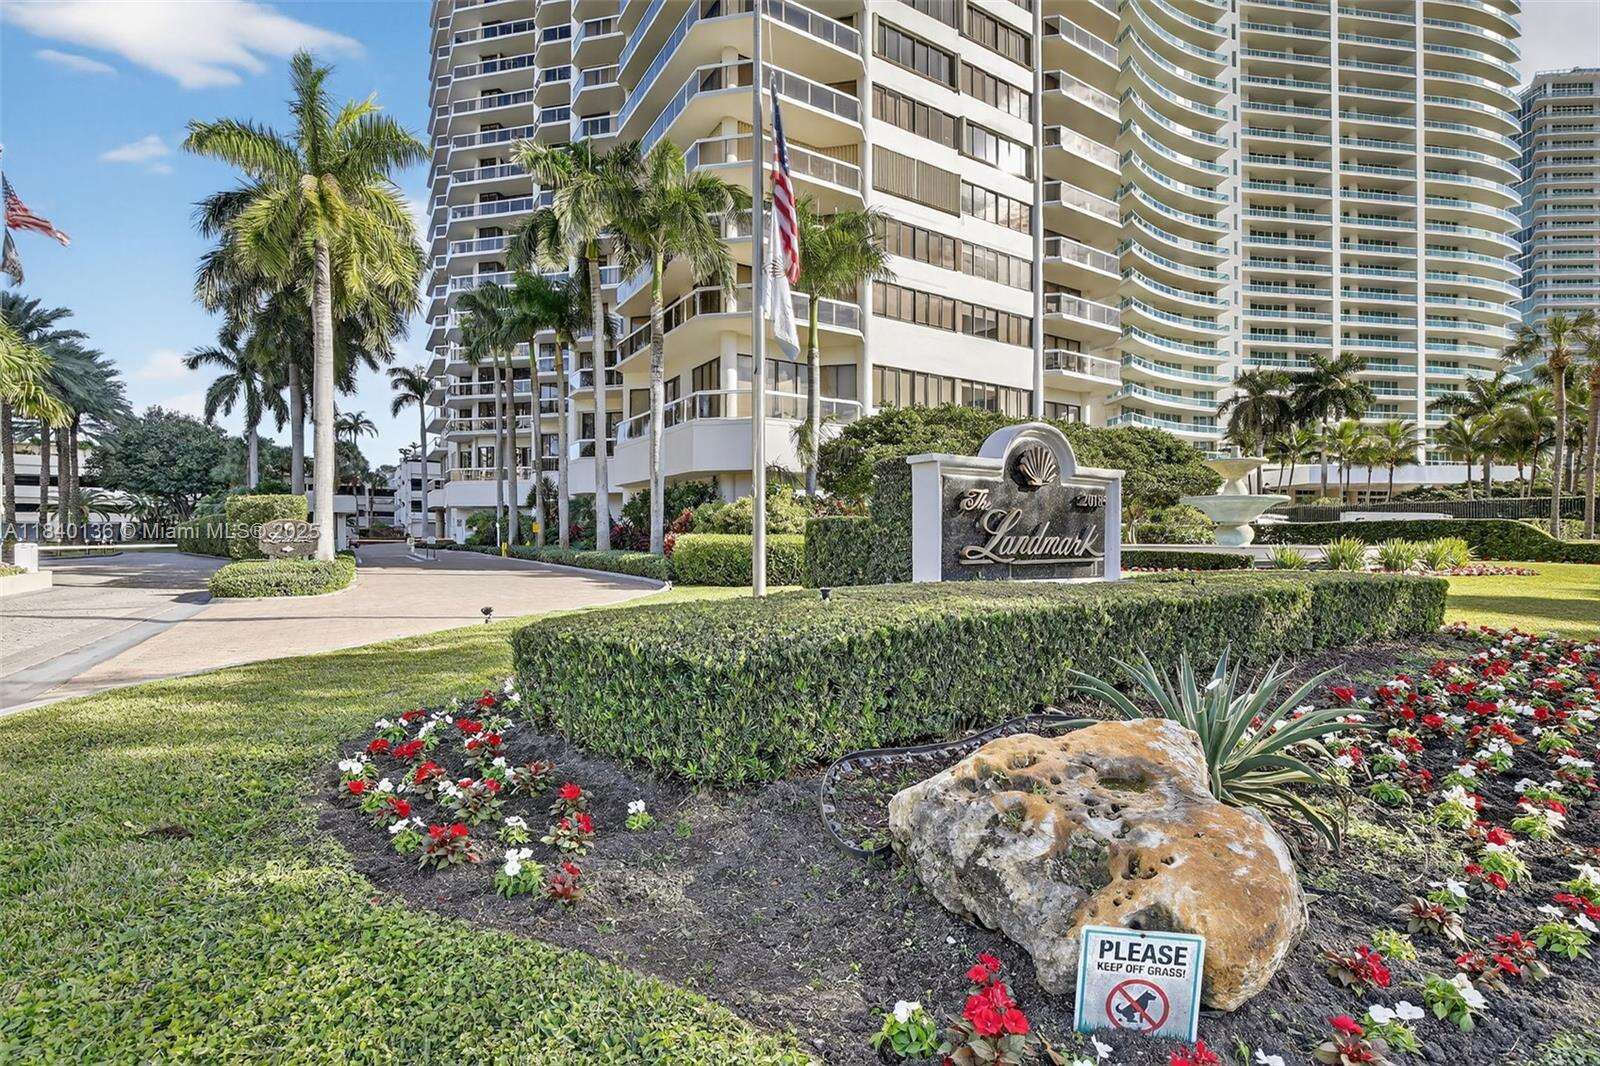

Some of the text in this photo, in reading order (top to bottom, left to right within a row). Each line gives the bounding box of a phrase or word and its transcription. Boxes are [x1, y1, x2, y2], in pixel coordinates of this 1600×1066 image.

[961, 488, 992, 511] The
[960, 508, 1105, 563] Landmark
[1099, 939, 1188, 966] PLEASE
[1097, 961, 1186, 979] KEEP OFF GRASS!
